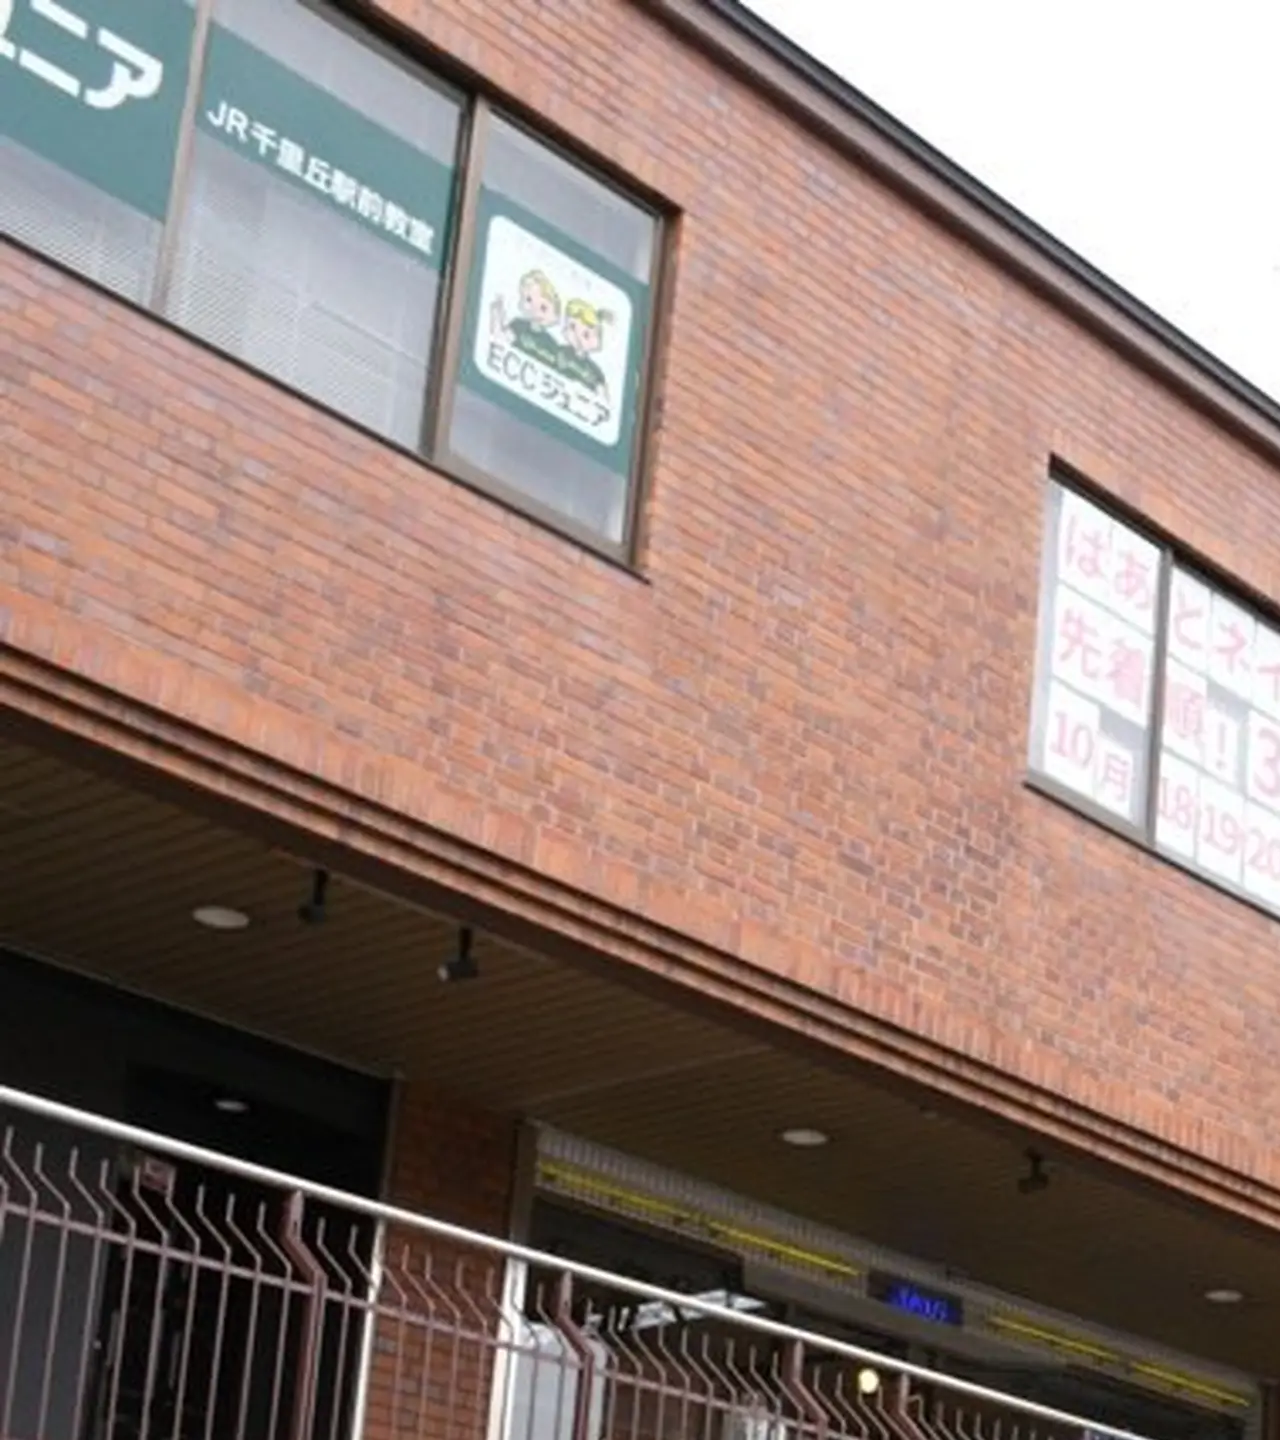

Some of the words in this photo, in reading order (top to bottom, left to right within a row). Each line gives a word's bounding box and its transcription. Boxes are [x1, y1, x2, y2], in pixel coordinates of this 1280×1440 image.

[206, 100, 435, 256] JR千里丘駅前教室
